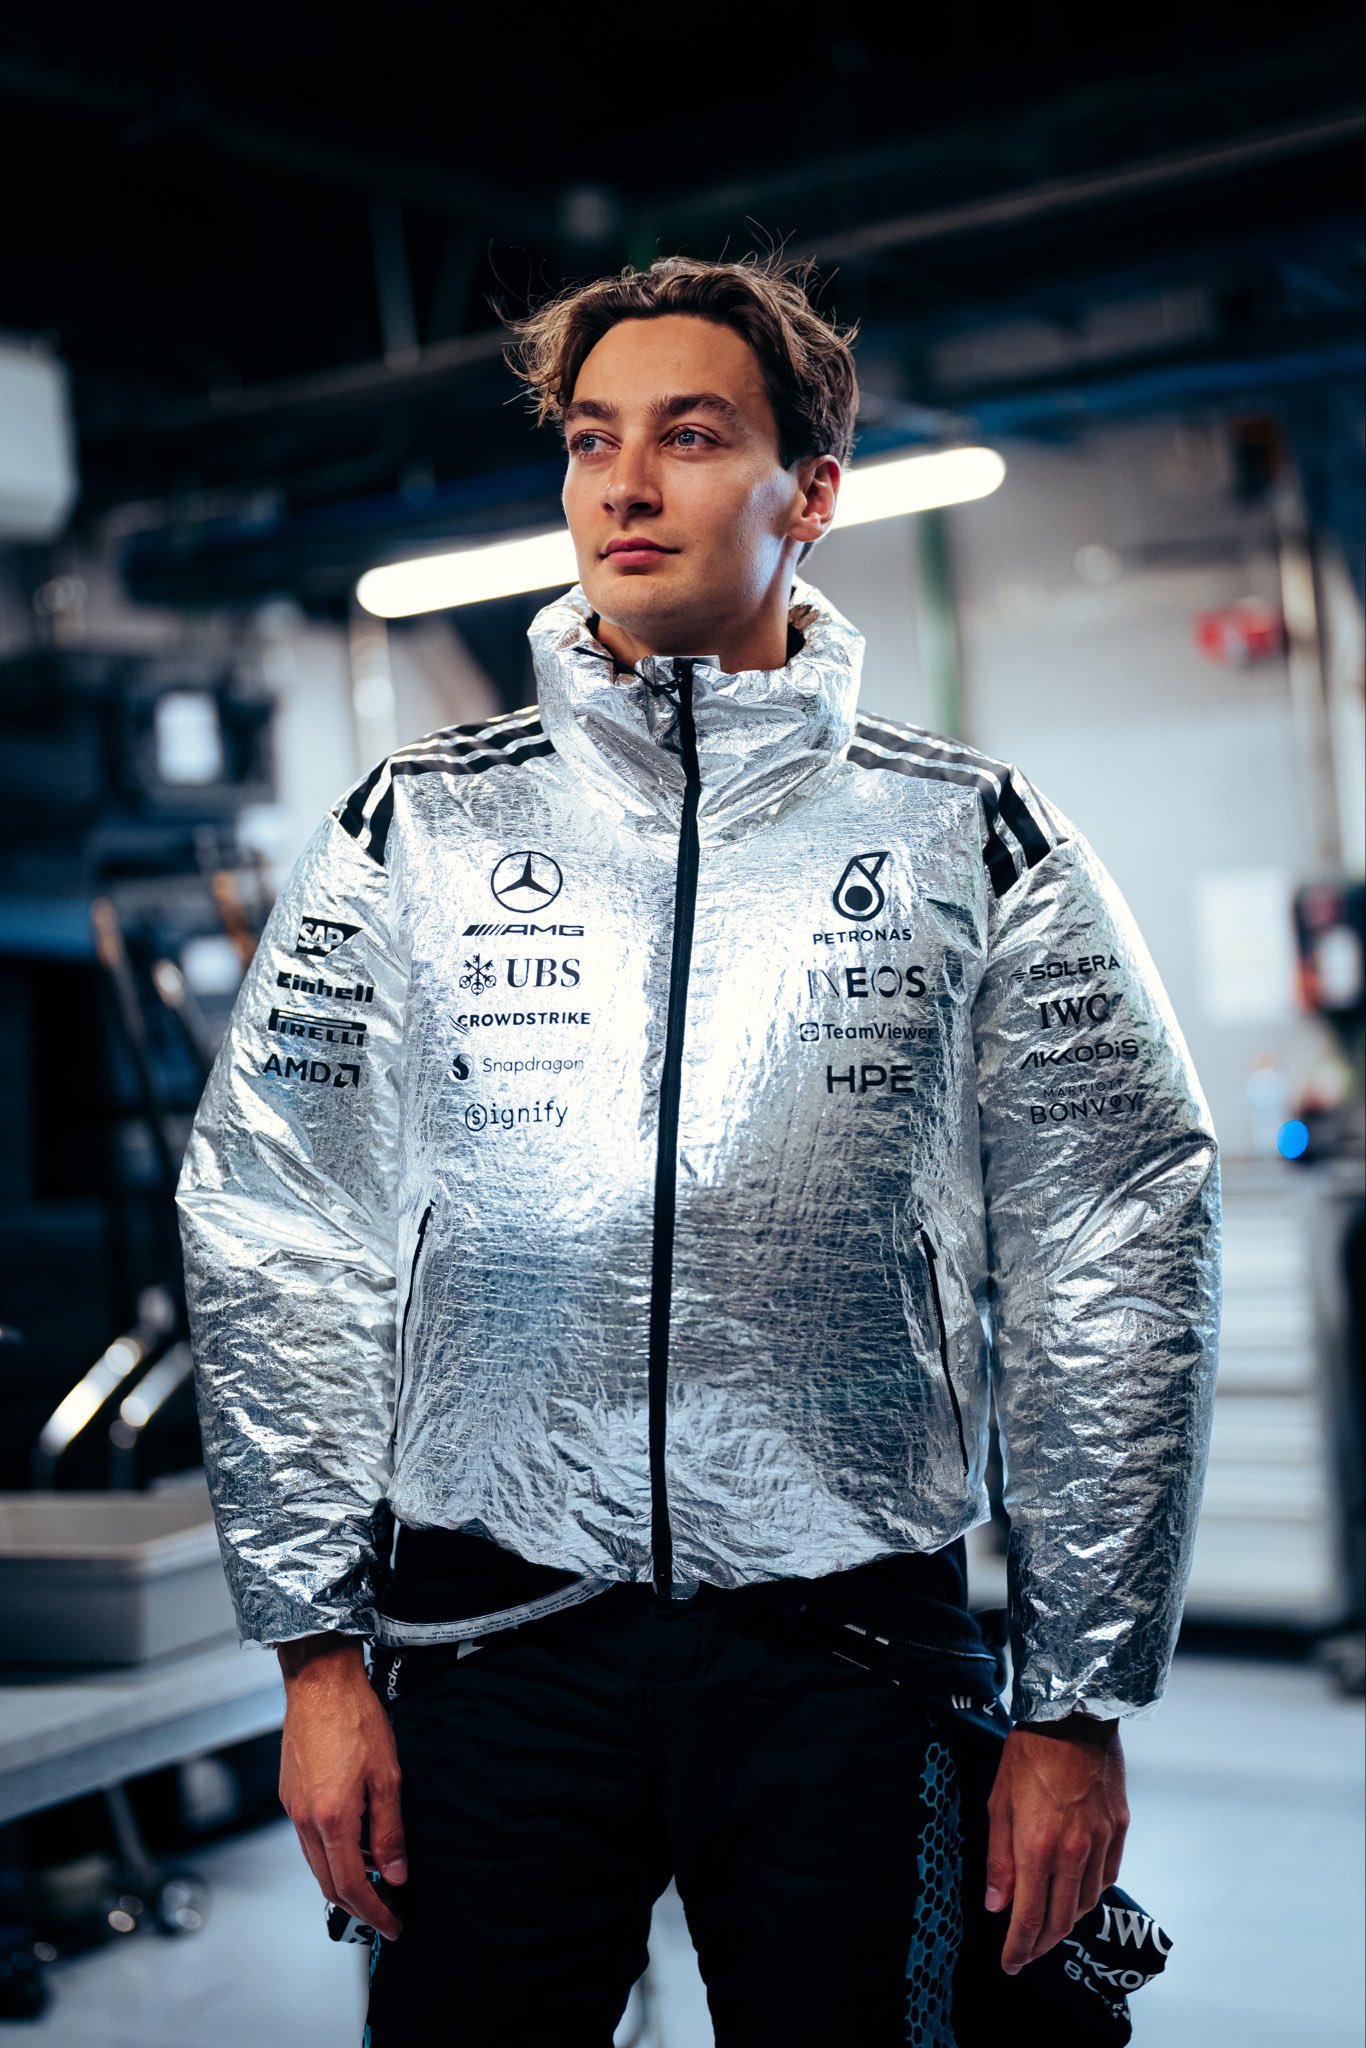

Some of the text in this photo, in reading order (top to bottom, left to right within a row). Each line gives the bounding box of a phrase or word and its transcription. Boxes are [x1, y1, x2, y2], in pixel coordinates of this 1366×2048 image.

[297, 921, 345, 953] SAP
[500, 923, 585, 937] AMG
[812, 928, 913, 945] PETRONAS
[505, 957, 581, 988] UBS
[806, 965, 927, 999] INEOS
[1029, 953, 1121, 981] SOLERA
[276, 970, 375, 1003] Einhell
[456, 1011, 592, 1029] CROWDSTRIKE
[1037, 992, 1111, 1030] IWC
[267, 1007, 368, 1046] PIRELLI
[822, 1022, 935, 1040] TeamViewer
[262, 1053, 332, 1084] AMD
[482, 1055, 584, 1076] Snapdragon
[826, 1064, 915, 1094] HPE
[1043, 1078, 1125, 1099] MARRIOTT
